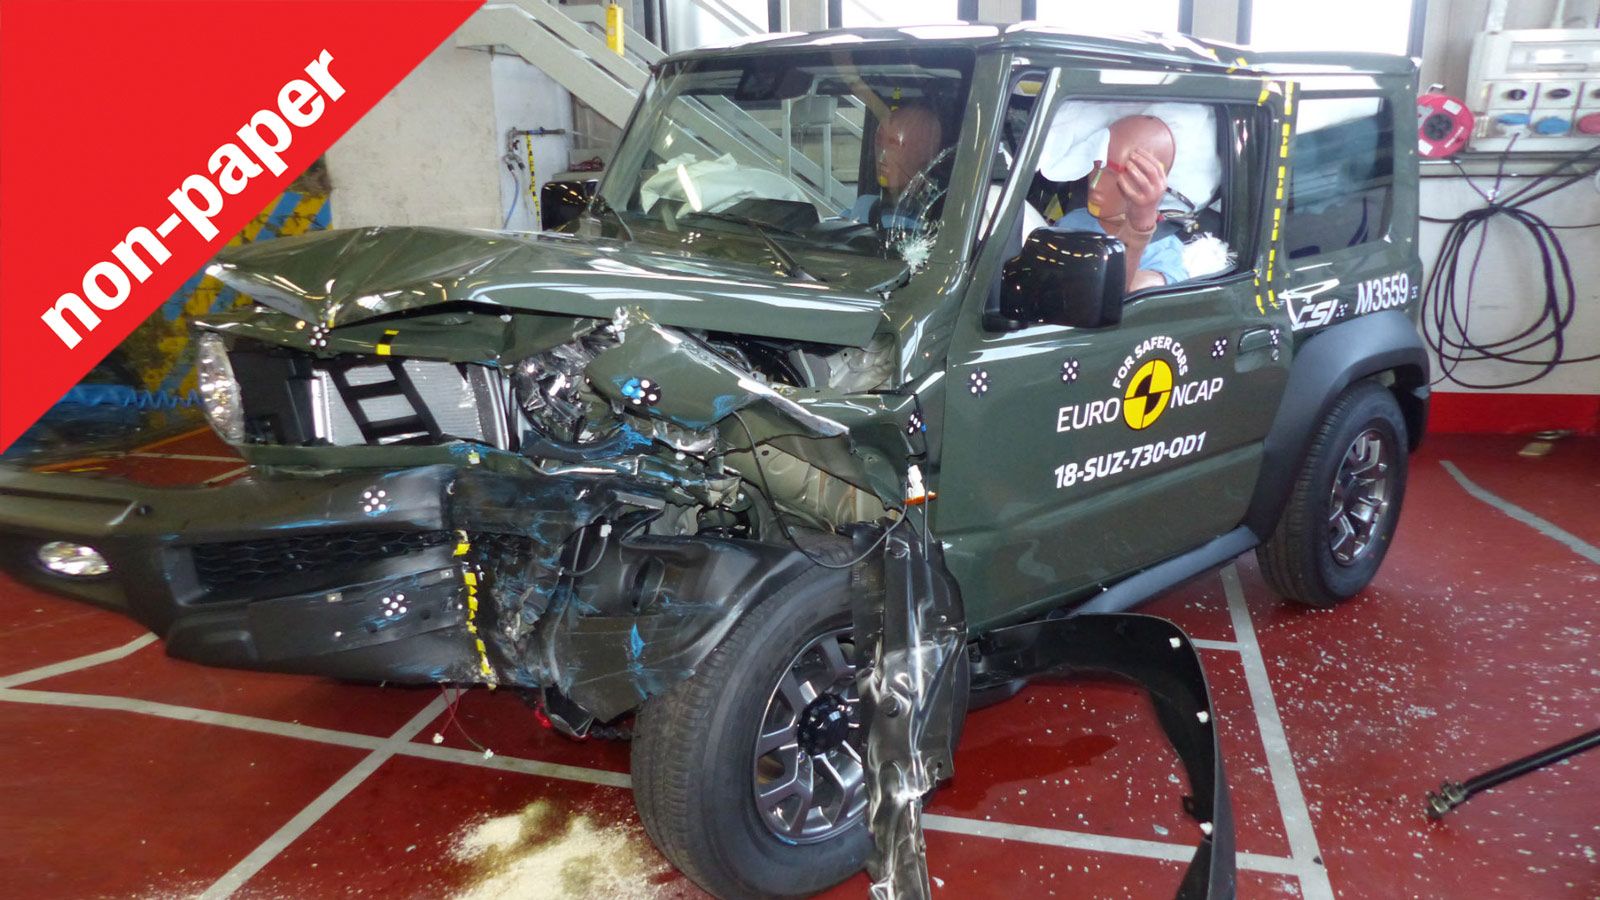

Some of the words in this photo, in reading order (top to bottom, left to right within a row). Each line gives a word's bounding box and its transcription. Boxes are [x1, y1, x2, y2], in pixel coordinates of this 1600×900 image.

[1354, 273, 1409, 315] M3559
[1112, 355, 1136, 389] FOR
[1134, 336, 1173, 359] SAFER
[1171, 342, 1189, 376] CARS
[1056, 397, 1121, 432] EURO
[1170, 377, 1224, 409] NCAP
